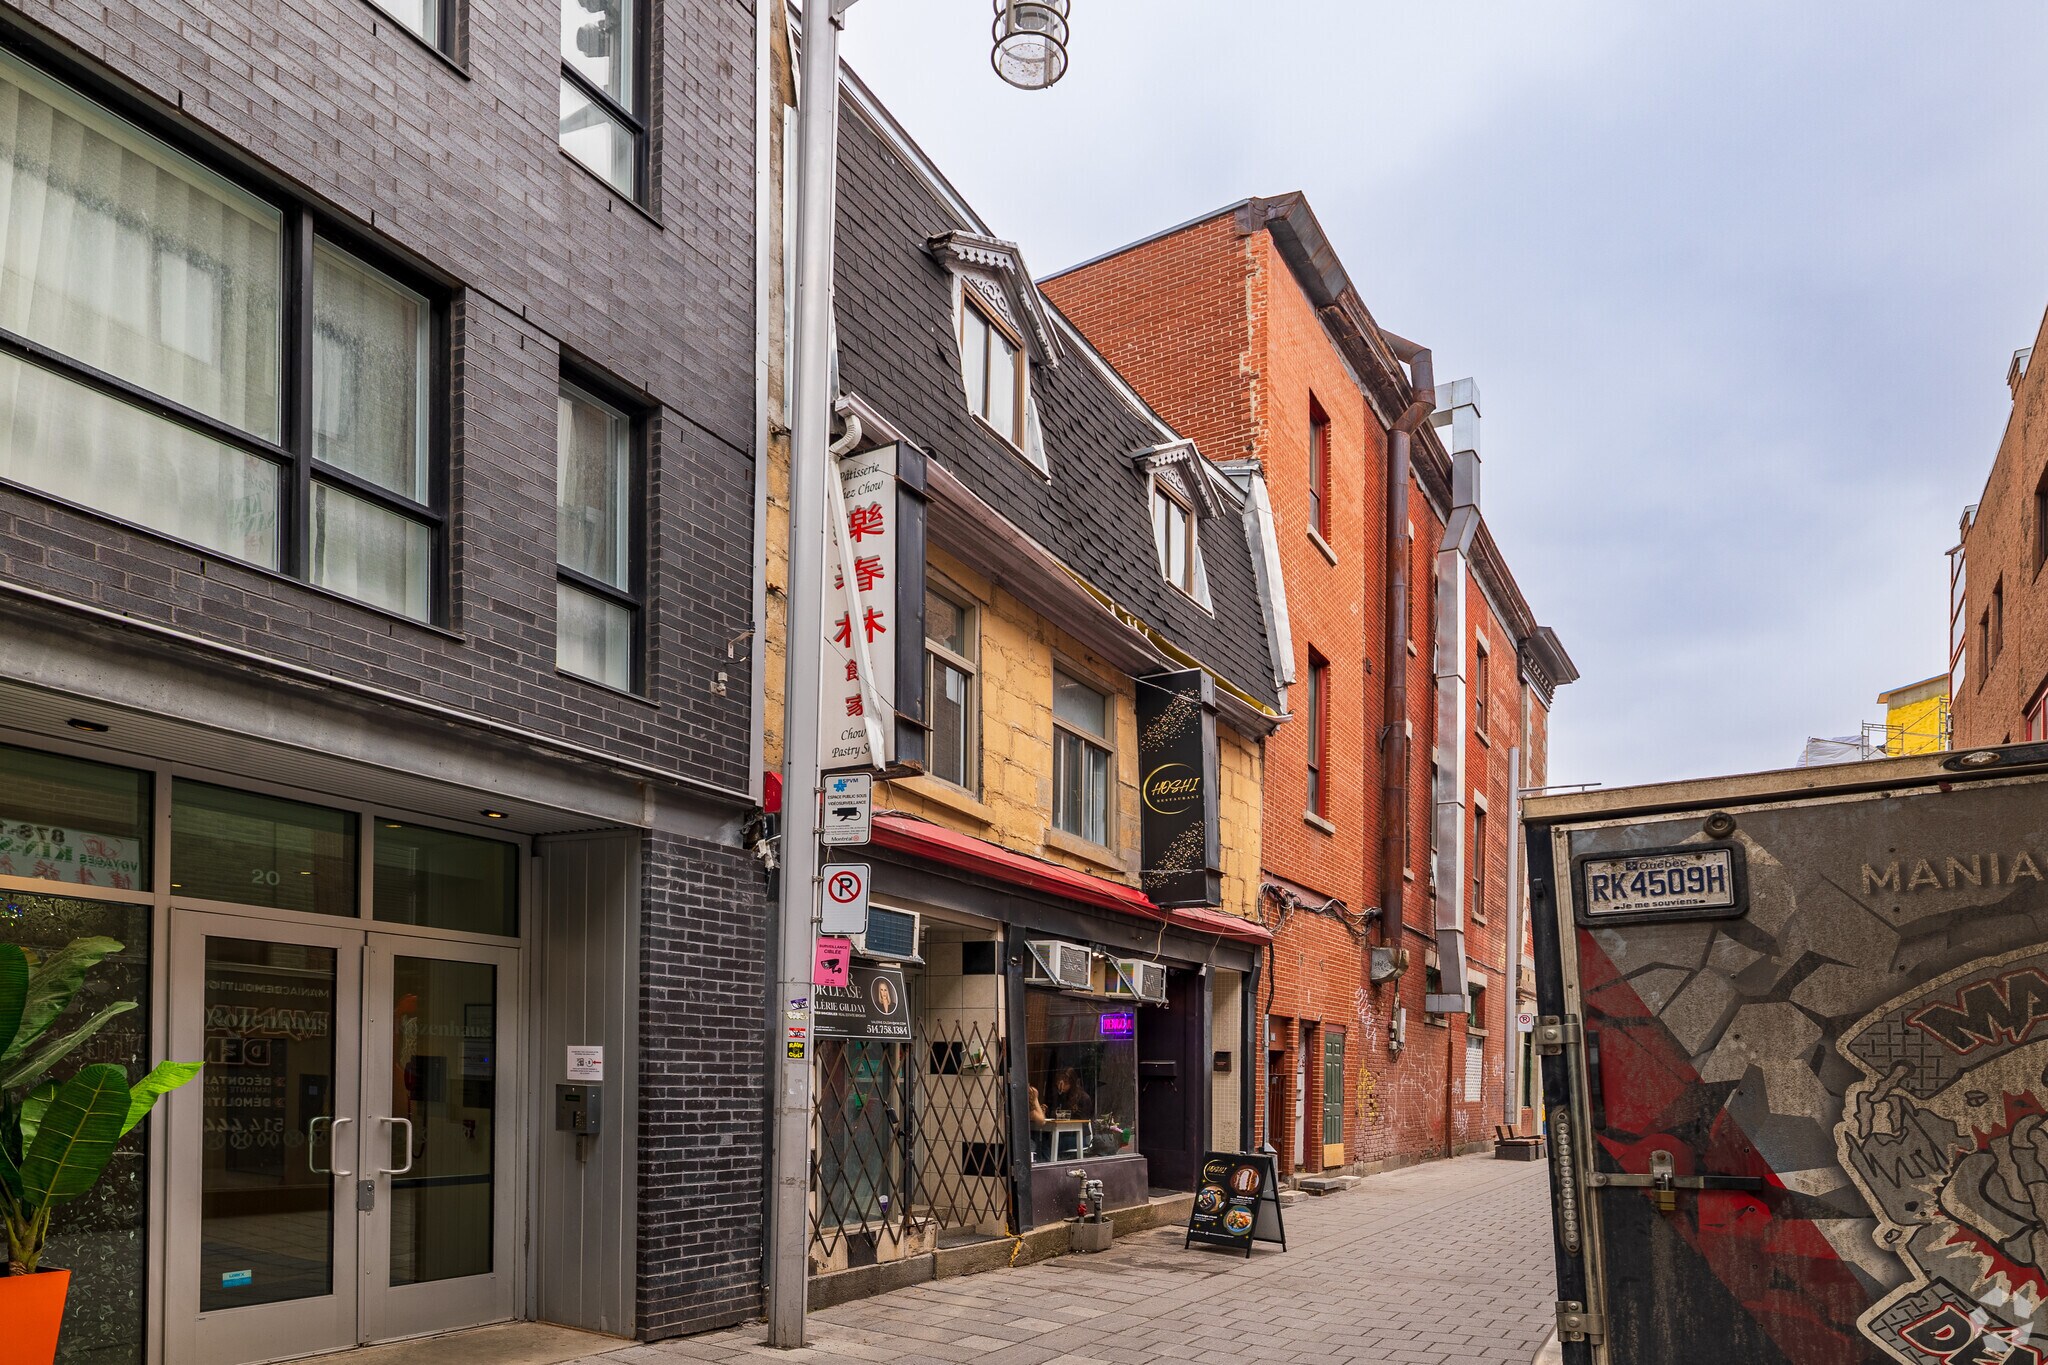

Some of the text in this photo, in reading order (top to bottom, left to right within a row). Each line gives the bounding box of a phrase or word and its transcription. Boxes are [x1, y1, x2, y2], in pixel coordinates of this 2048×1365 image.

[857, 480, 884, 496] Chow
[831, 745, 861, 760] Pastry
[1151, 777, 1201, 796] HOSHI
[1156, 795, 1200, 803] RESTAURANT
[250, 868, 282, 887] 20
[1861, 850, 2048, 895] MANIA
[1592, 864, 1727, 902] RK4509H
[1652, 898, 1698, 907] souviens
[839, 1002, 866, 1013] GILDAY
[867, 1024, 908, 1035] 514.758.1384
